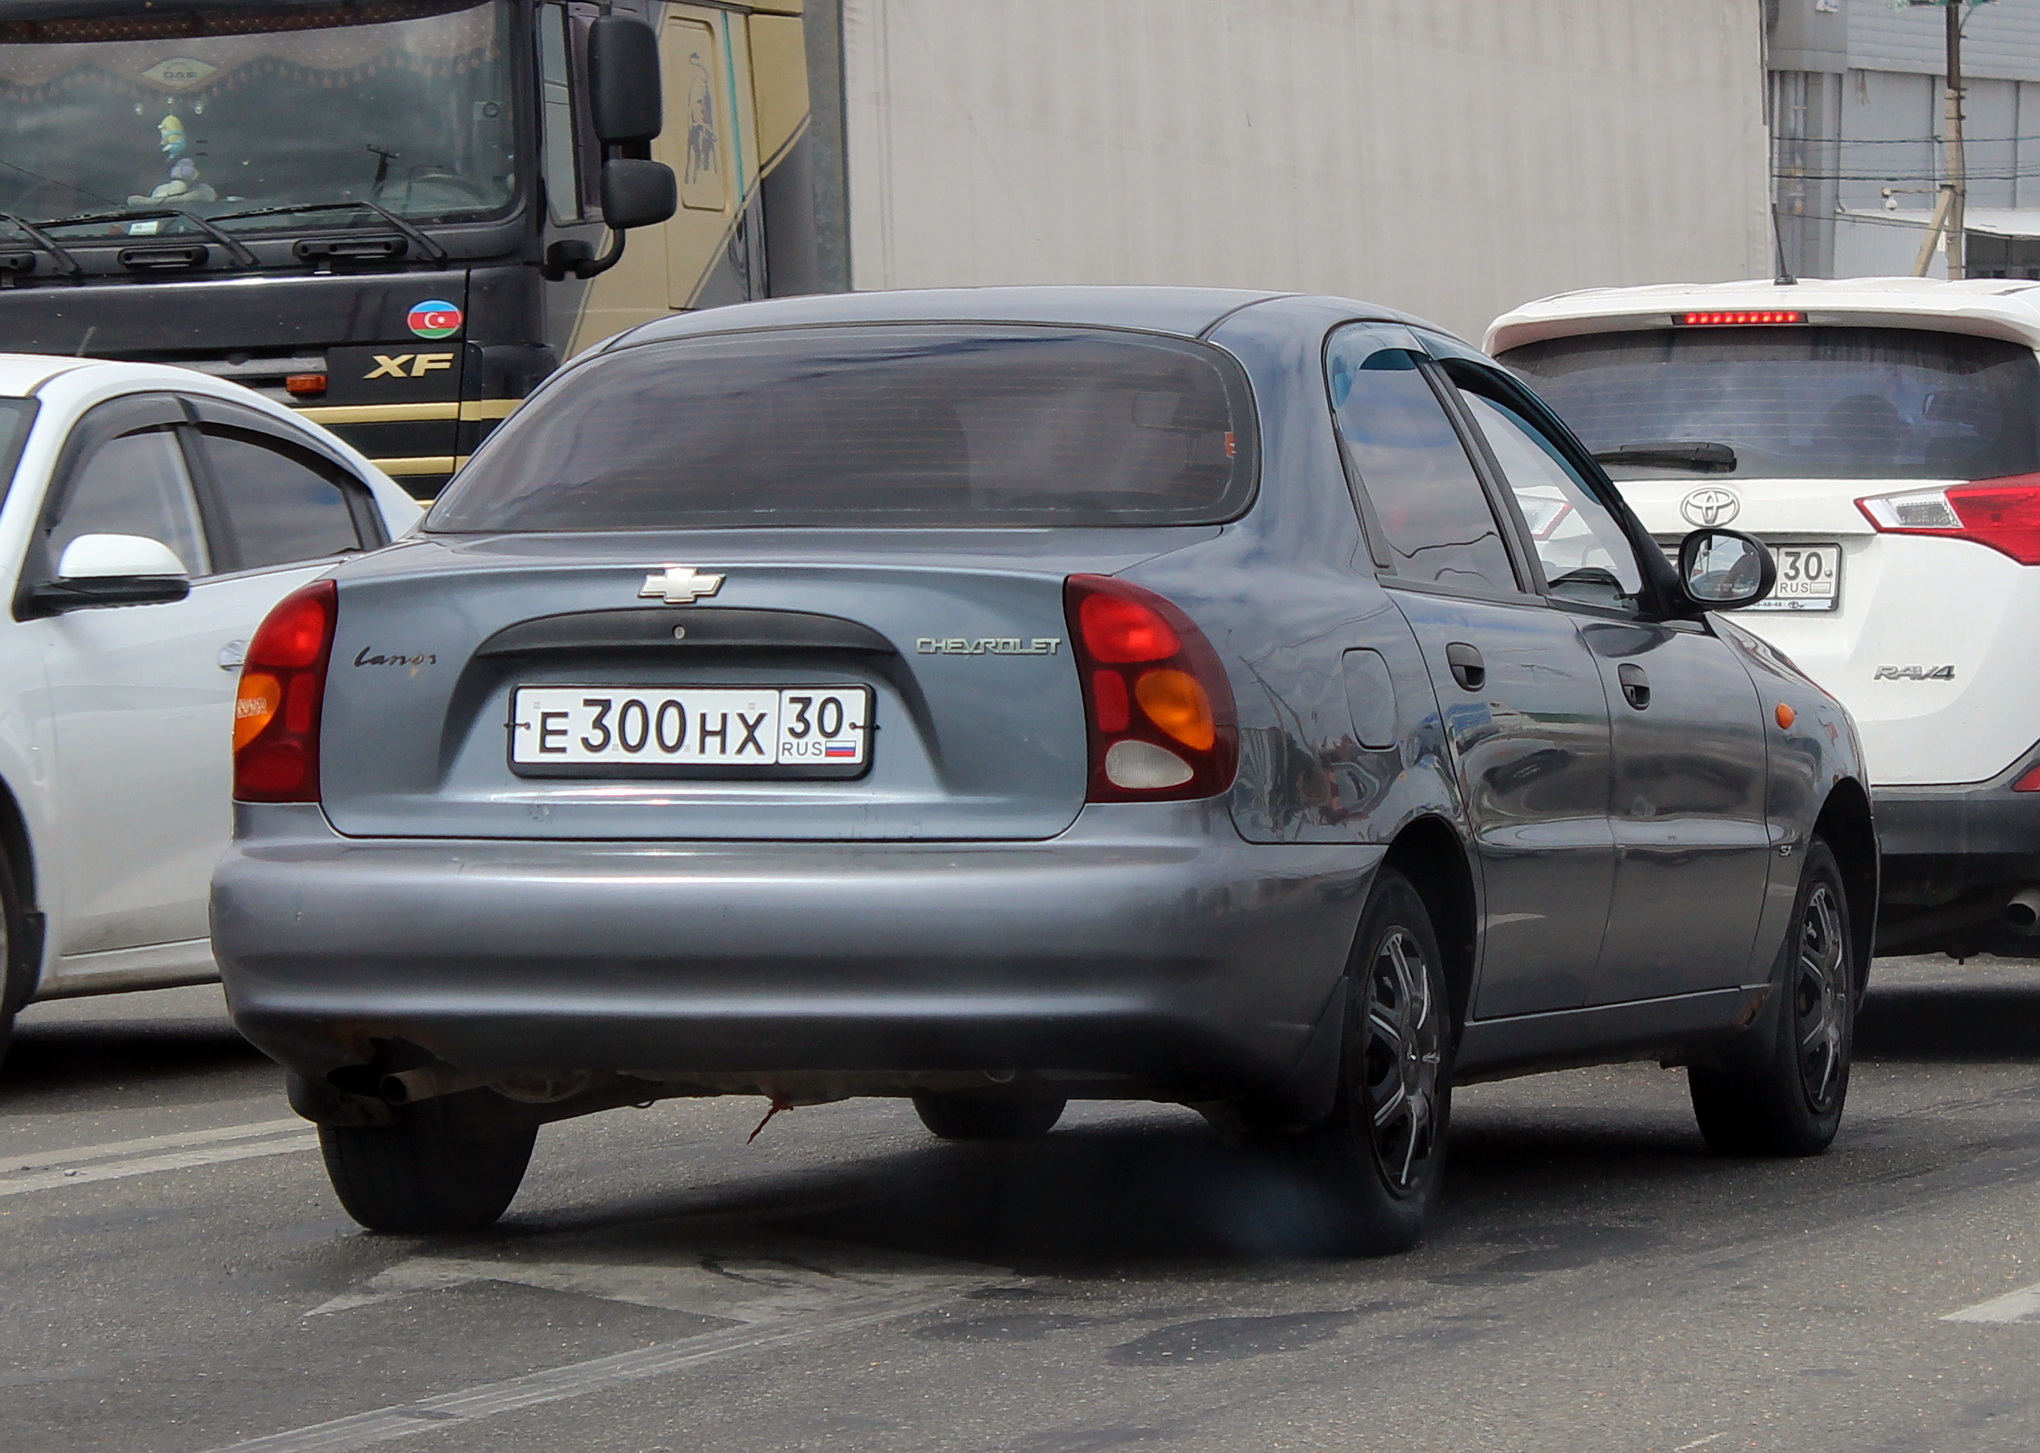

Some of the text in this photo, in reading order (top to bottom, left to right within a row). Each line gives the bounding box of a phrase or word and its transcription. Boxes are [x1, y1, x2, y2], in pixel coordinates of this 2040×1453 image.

[362, 352, 454, 379] XF
[1783, 551, 1823, 581] 30
[1780, 582, 1809, 593] RUS
[916, 638, 1062, 655] CHEVROLET
[1873, 665, 1955, 681] RAV4
[787, 697, 843, 738] 30
[781, 741, 822, 757] RUS
